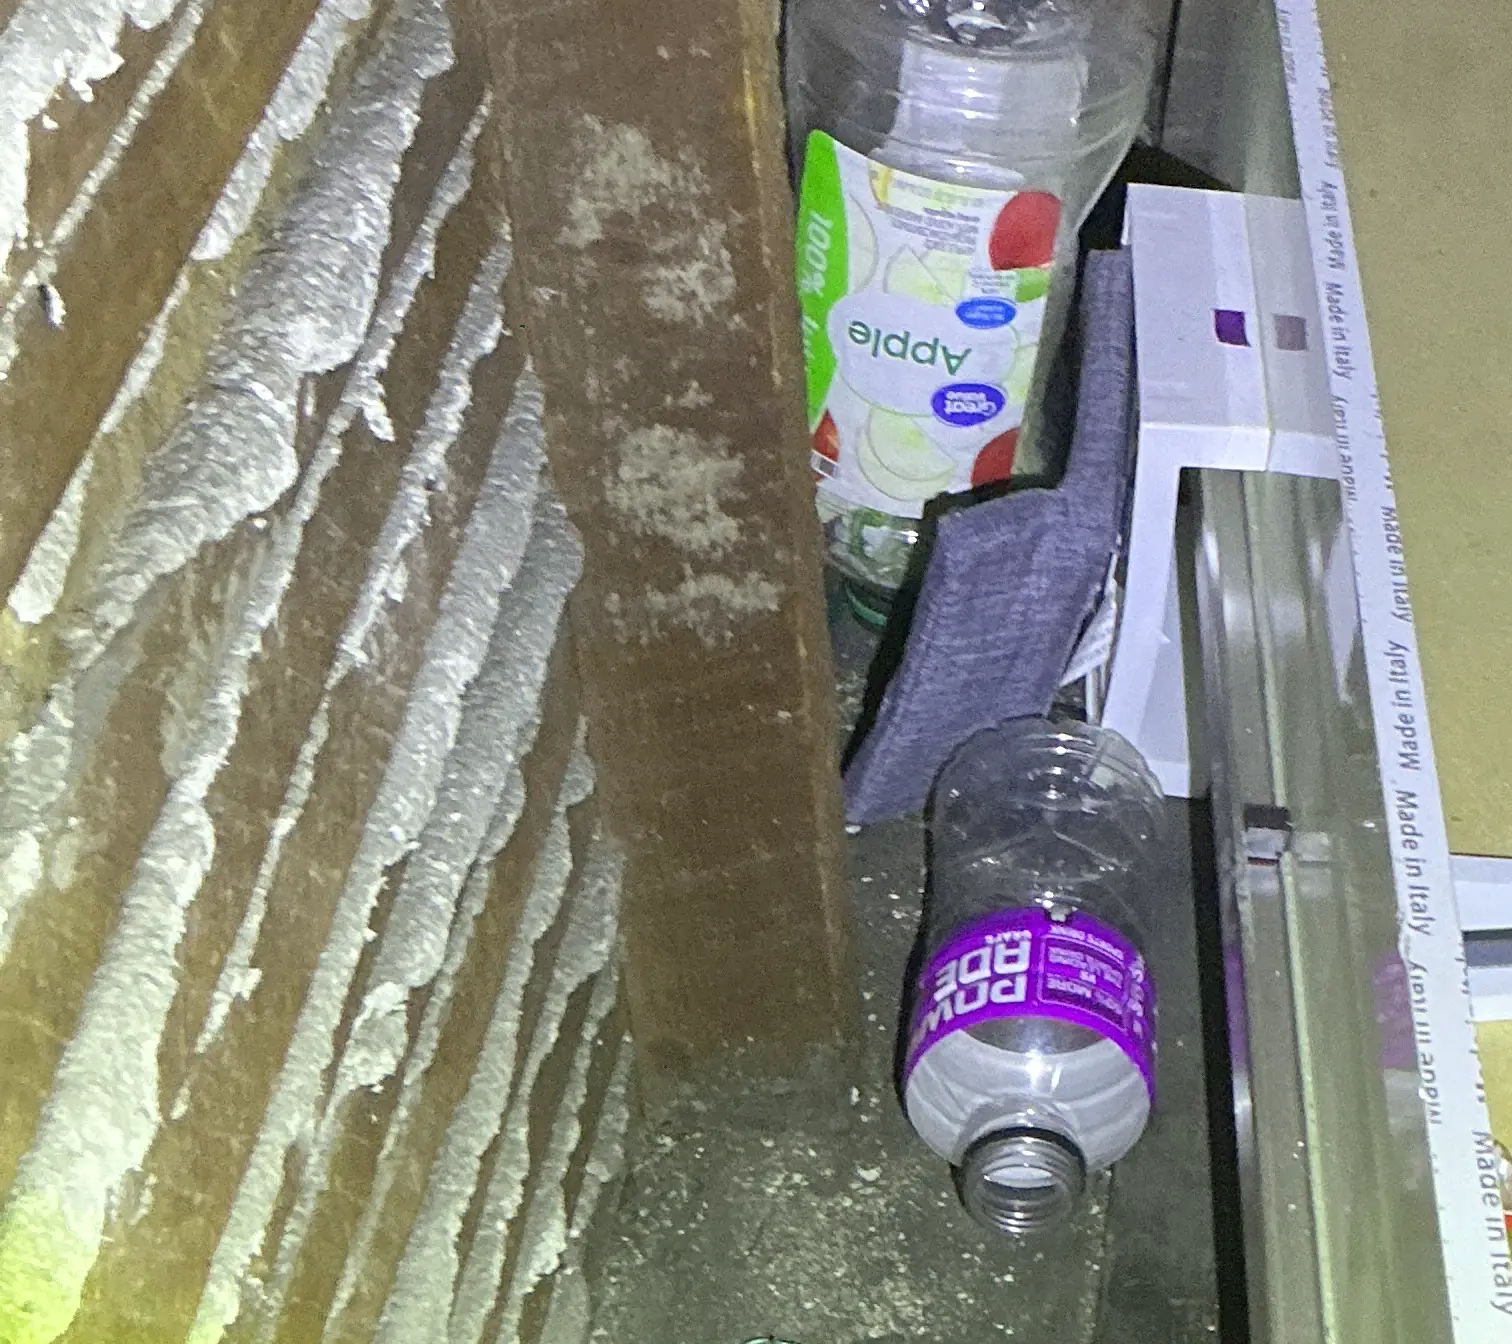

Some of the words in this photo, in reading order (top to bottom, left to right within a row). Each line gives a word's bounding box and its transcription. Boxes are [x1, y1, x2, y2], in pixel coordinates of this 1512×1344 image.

[1316, 179, 1338, 211] Italy
[1322, 215, 1339, 228] in
[1323, 231, 1346, 270] Made
[1323, 281, 1350, 323] Made
[848, 319, 972, 375] Apple
[1329, 326, 1350, 341] in
[1331, 345, 1356, 381] Italy
[943, 399, 997, 416] Great
[1383, 640, 1410, 683] Italy
[1391, 688, 1414, 709] in
[1397, 712, 1421, 771] Made
[1397, 789, 1423, 851] Made
[1404, 860, 1430, 881] in
[1407, 886, 1436, 937] Italy
[934, 941, 1031, 1001] ADE
[919, 973, 1027, 1036] POW
[1471, 1130, 1500, 1208] Made
[1485, 1217, 1504, 1242] in
